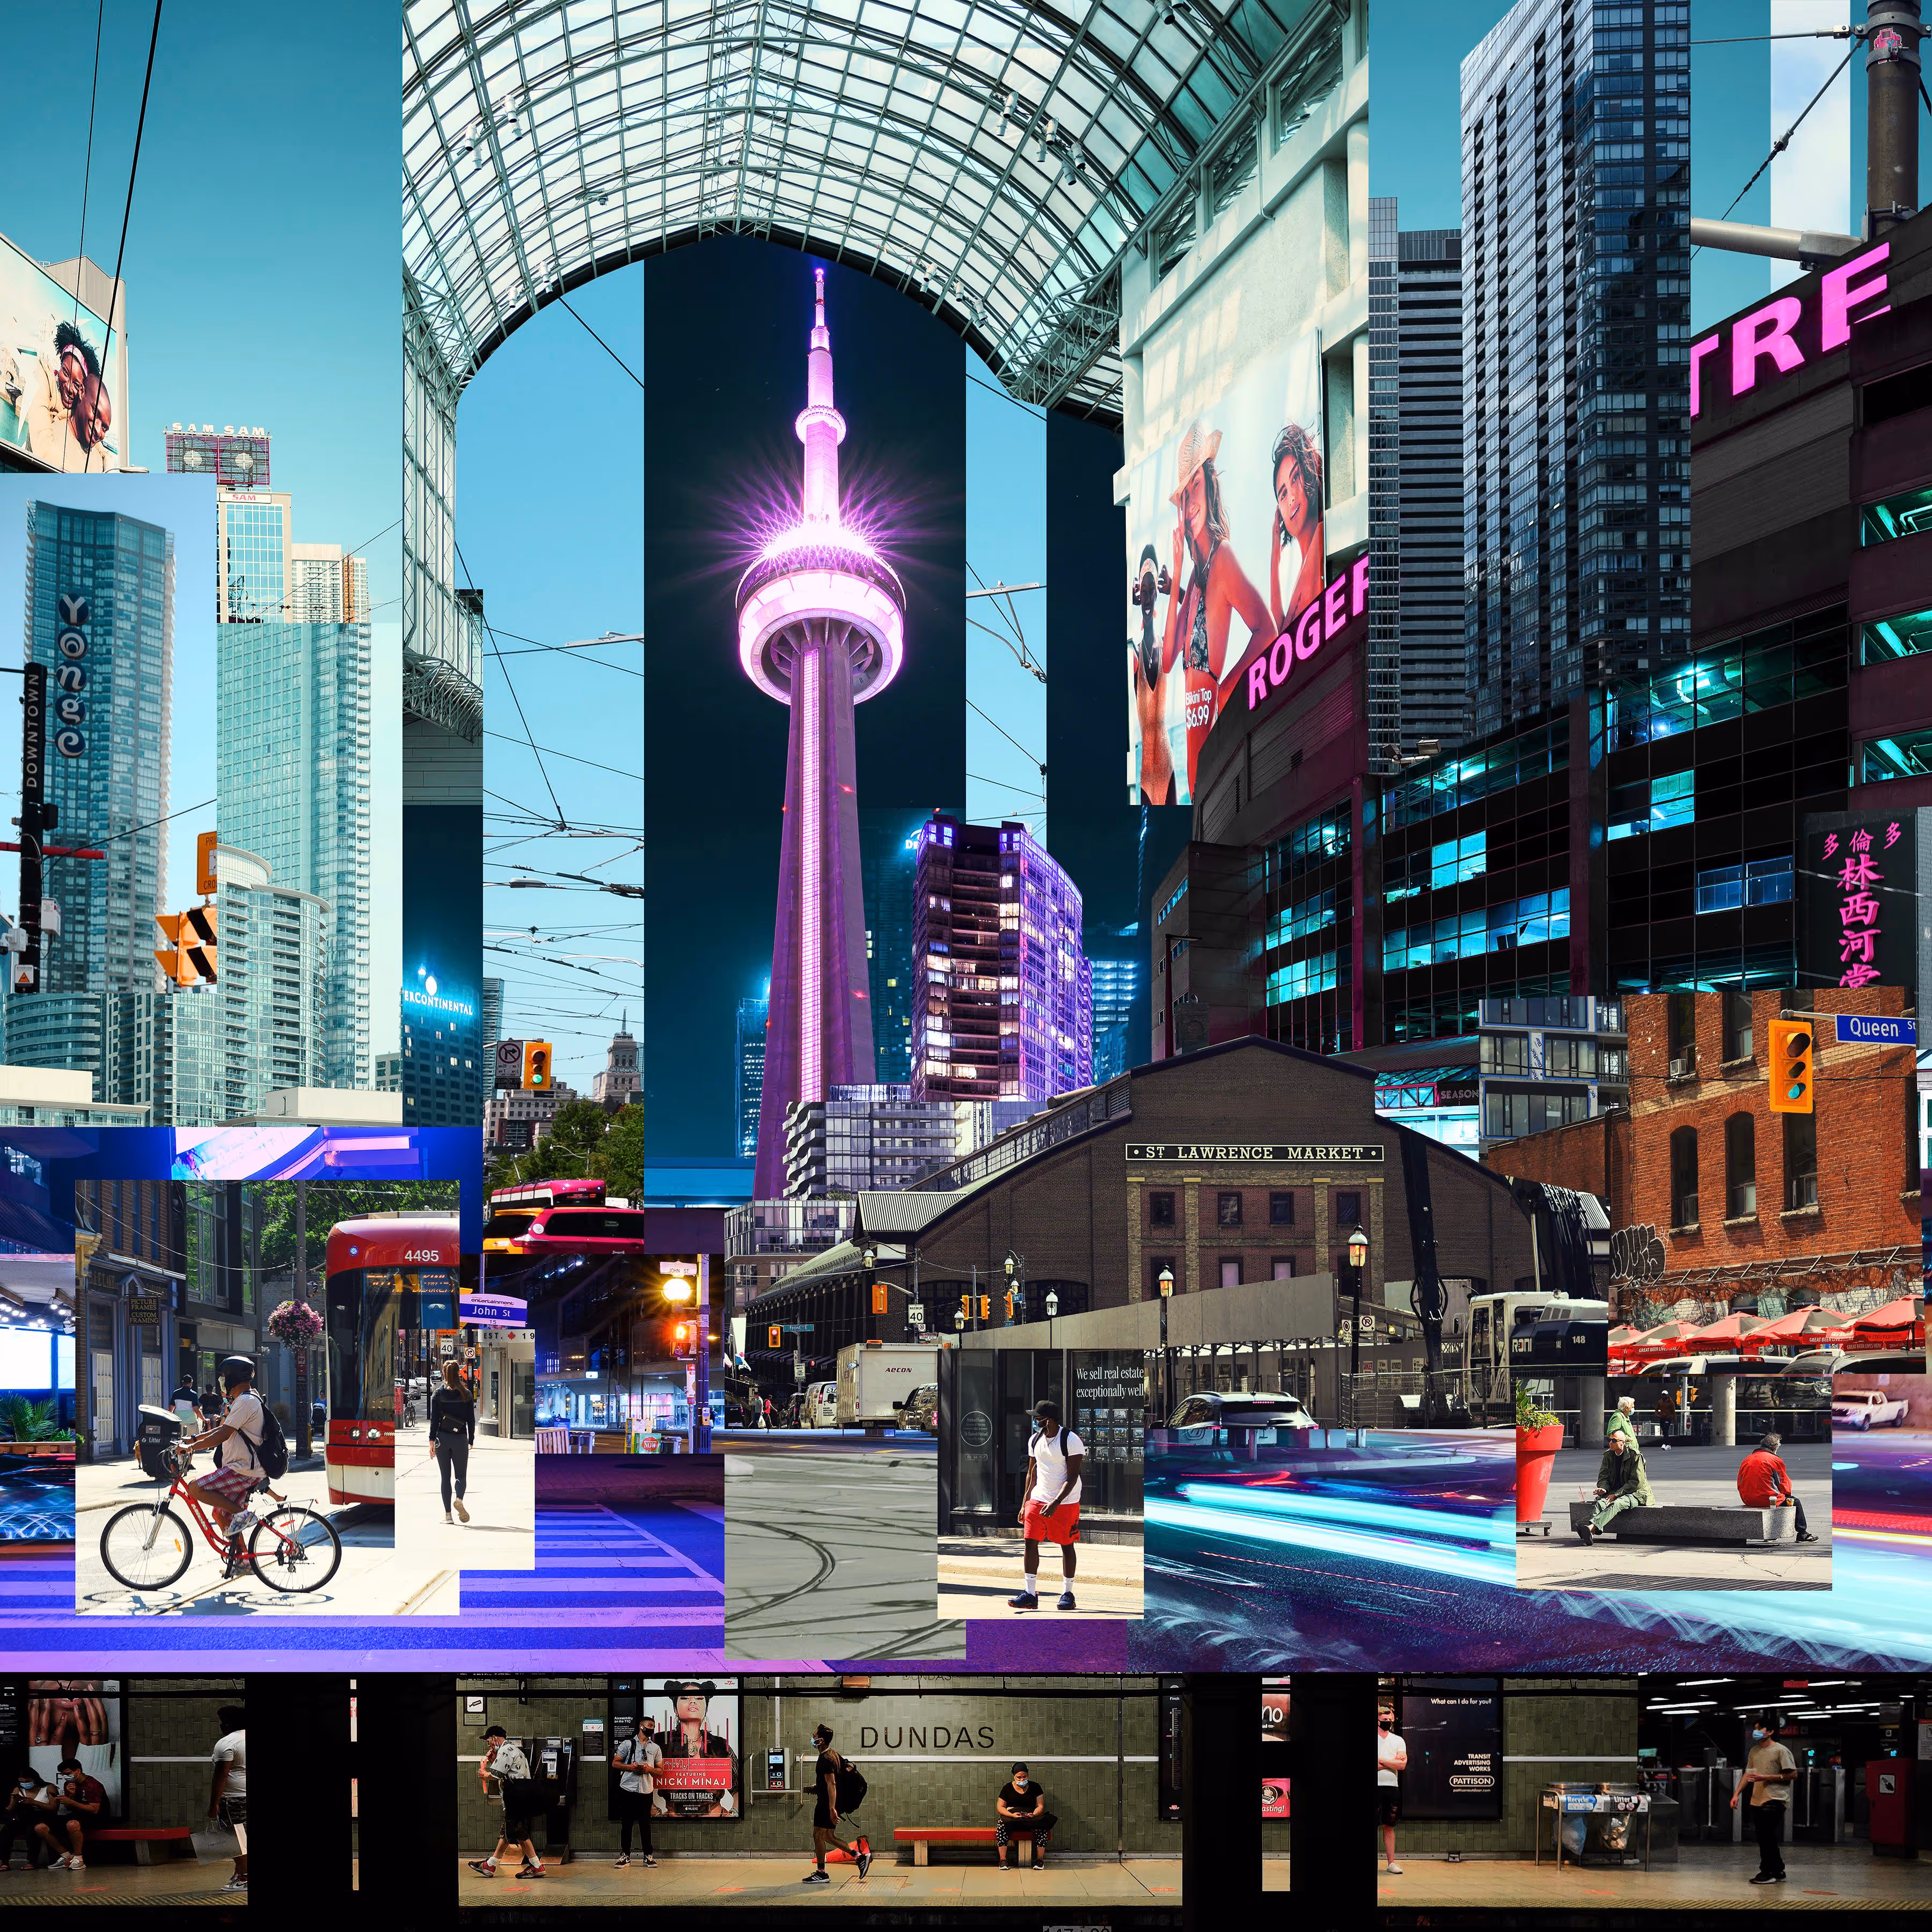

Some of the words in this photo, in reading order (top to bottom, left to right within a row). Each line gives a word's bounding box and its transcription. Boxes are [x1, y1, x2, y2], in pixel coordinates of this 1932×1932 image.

[172, 422, 214, 433] SAM
[224, 425, 265, 436] SAM
[1185, 690, 1200, 706] Bikini
[1201, 688, 1212, 704] Top
[1187, 705, 1209, 730] $6.99
[27, 674, 39, 788] DOWNTOWN
[203, 880, 217, 890] CRO
[402, 990, 473, 1016] ERCONTINENTAL
[1850, 1018, 1899, 1037] Queen
[1441, 1089, 1479, 1099] SEASON
[1178, 1147, 1273, 1159] LAWRENCE
[1287, 1147, 1364, 1159] MARKET
[405, 1249, 439, 1262] 4495
[471, 1298, 514, 1306] entertainment
[472, 1306, 497, 1315] John
[910, 1313, 923, 1321] 40
[1572, 1336, 1585, 1344] 148
[1077, 1368, 1088, 1380] We
[1089, 1367, 1102, 1380] sell
[1104, 1366, 1119, 1379] real
[1121, 1367, 1144, 1379] estate
[1077, 1384, 1126, 1400] exceptionally
[1128, 1383, 1144, 1396] well
[643, 1441, 657, 1449] NOW
[861, 1726, 994, 1748] DUNDAS
[1568, 1796, 1589, 1804] Recycle
